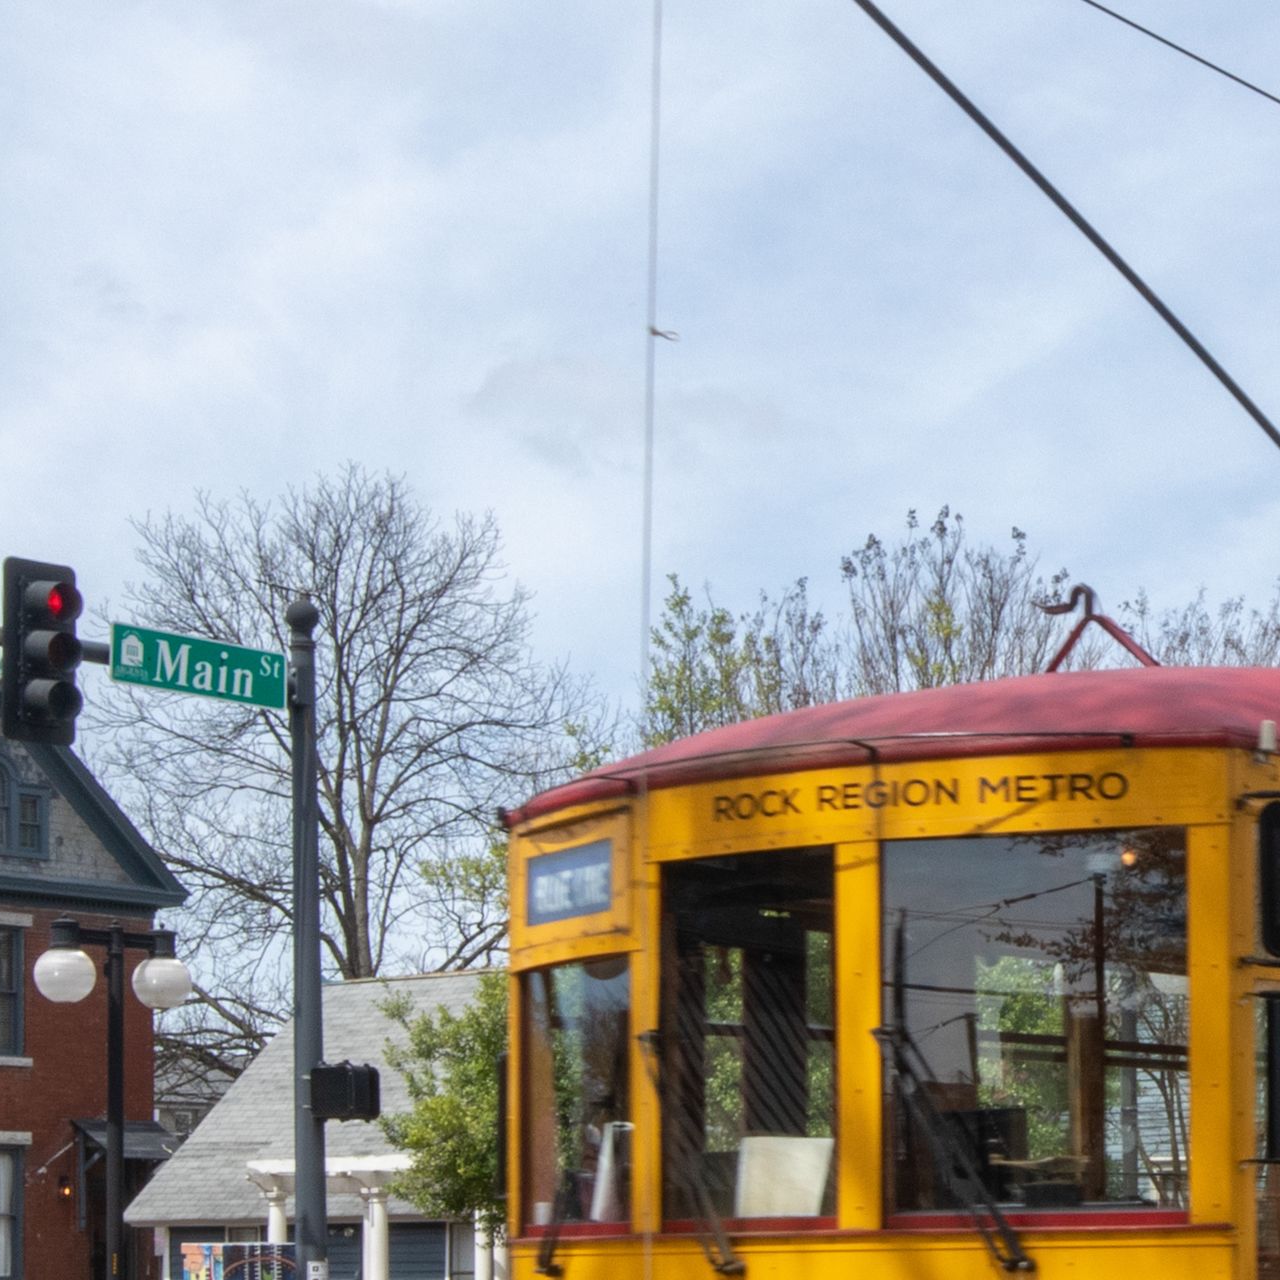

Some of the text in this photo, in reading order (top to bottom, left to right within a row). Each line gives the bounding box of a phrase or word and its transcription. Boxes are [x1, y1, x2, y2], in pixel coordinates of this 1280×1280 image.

[152, 638, 281, 698] Main St
[713, 771, 1129, 821] ROCK REGION METRO
